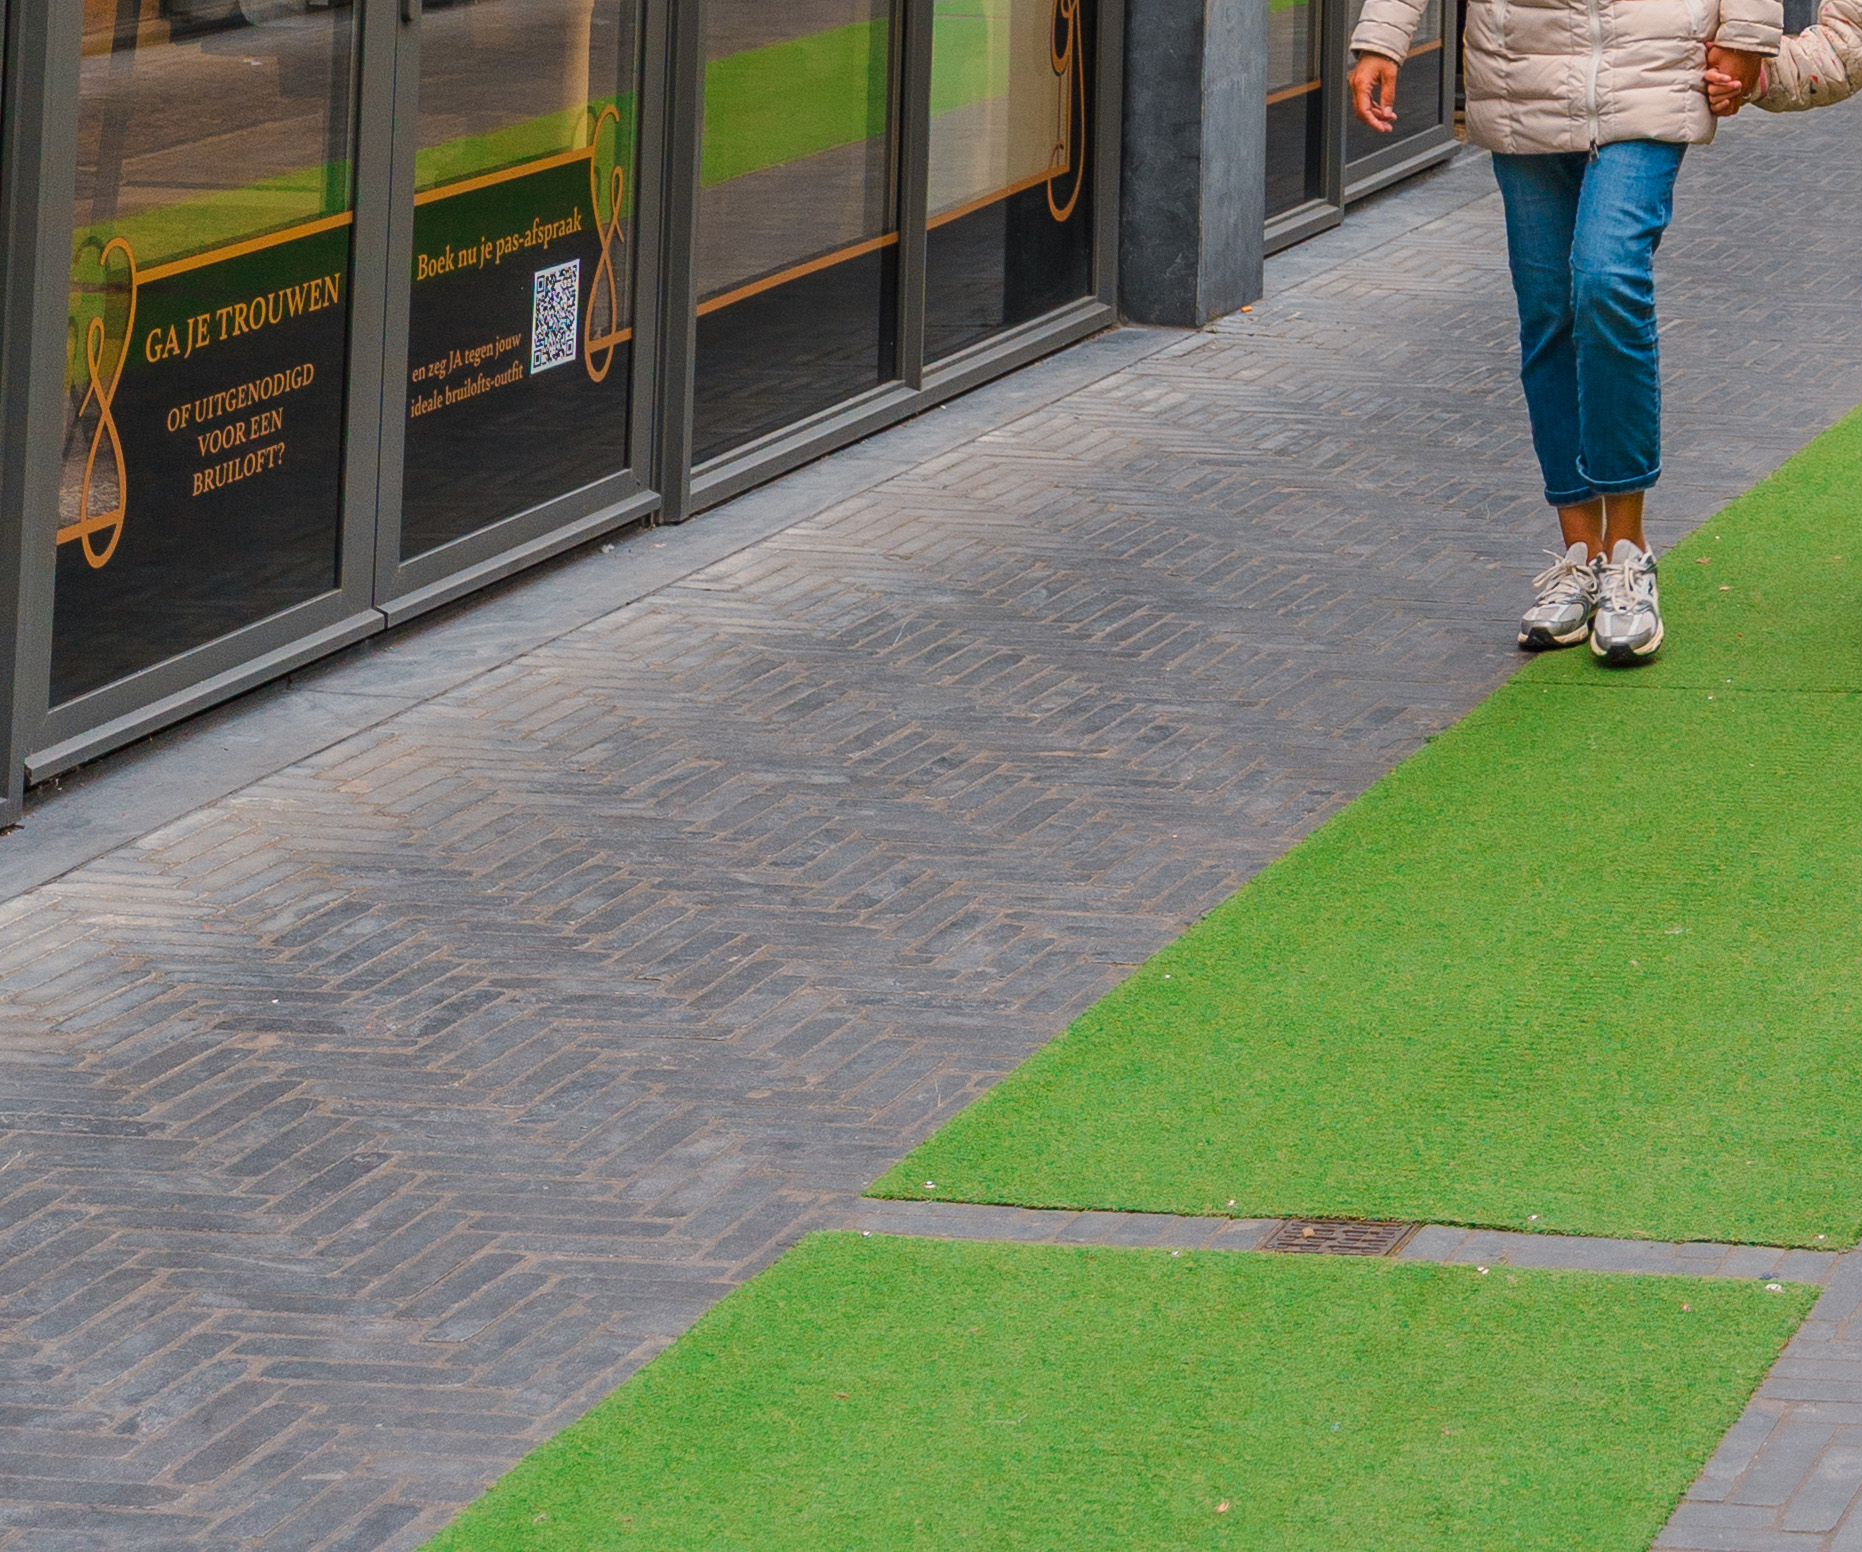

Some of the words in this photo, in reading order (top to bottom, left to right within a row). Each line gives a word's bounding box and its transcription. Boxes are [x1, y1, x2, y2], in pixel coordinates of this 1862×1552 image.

[416, 244, 455, 281] Boek
[457, 246, 477, 268] nu
[478, 236, 493, 269] je
[494, 206, 583, 264] pas-afspraak
[145, 323, 181, 363] GA
[184, 313, 210, 359] JE
[216, 273, 342, 341] TROUWEN
[412, 365, 426, 383] en
[428, 360, 448, 379] zeg
[448, 350, 463, 374] JA
[464, 343, 494, 367] tegen
[493, 333, 522, 361] jouw
[167, 403, 191, 432] OF
[194, 363, 315, 423] UITGENODIGD
[410, 389, 443, 419] ideale
[445, 359, 524, 406] bruilofts-outfit
[197, 421, 247, 457] VOOR
[249, 407, 284, 440] EEN
[192, 441, 286, 497] BRUILOFT?
